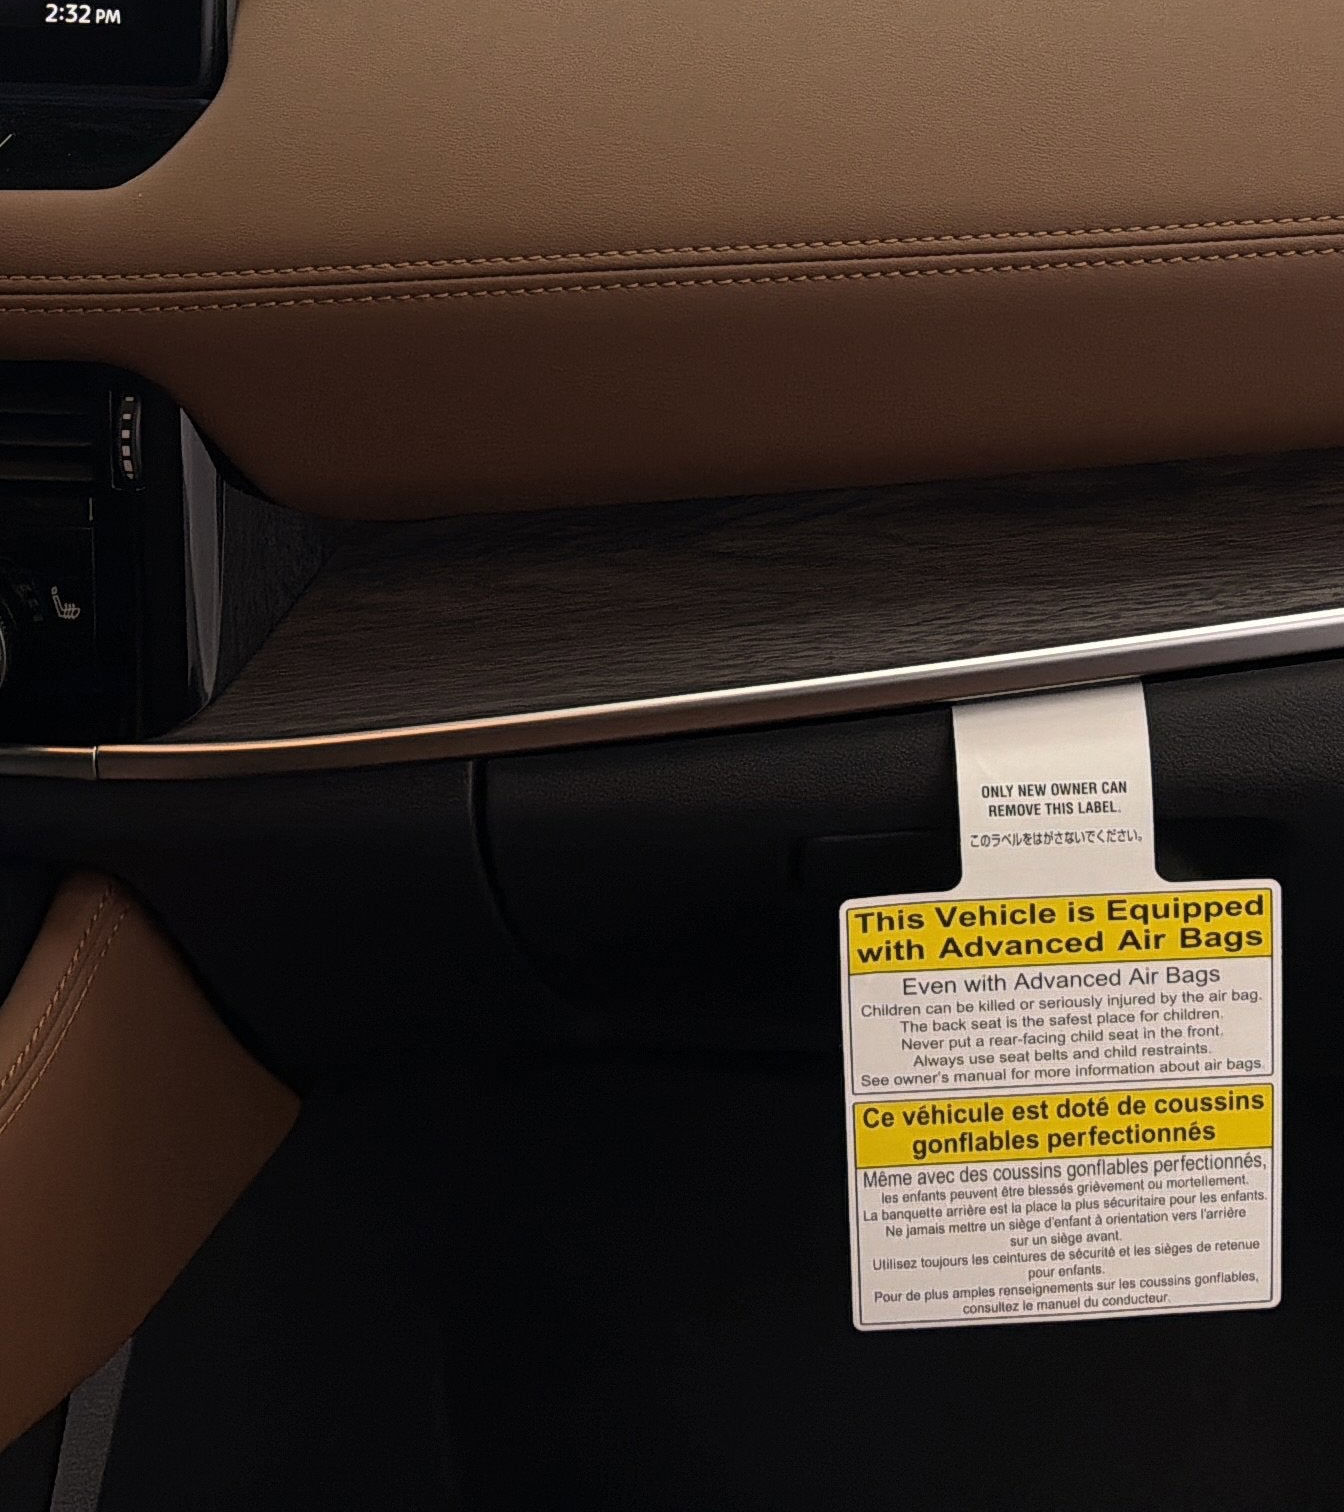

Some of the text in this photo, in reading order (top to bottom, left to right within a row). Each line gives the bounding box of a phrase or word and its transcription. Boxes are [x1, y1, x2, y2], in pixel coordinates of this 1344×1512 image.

[45, 3, 121, 25] 2:32 PM
[980, 780, 1127, 798] ONLY NEW OWNER CAN
[987, 800, 1121, 817] REMOVE THIS LABEL.
[853, 895, 1264, 933] This Vehicle is Equipped
[856, 927, 1263, 963] with Advanced Air Bags
[902, 967, 1221, 995] Even with Advanced Air Bags
[860, 989, 1262, 1017] Children can be killed or seriously injured by the air bag.
[900, 1024, 1224, 1051] Never put a rear-facing child seat in the front.
[862, 1091, 1265, 1128] Ce véhicule est doté de coussins
[911, 1122, 1216, 1159] gonflables perfectionnés
[862, 1154, 1267, 1188] Même avec des coussins gonflables perfectionnés,
